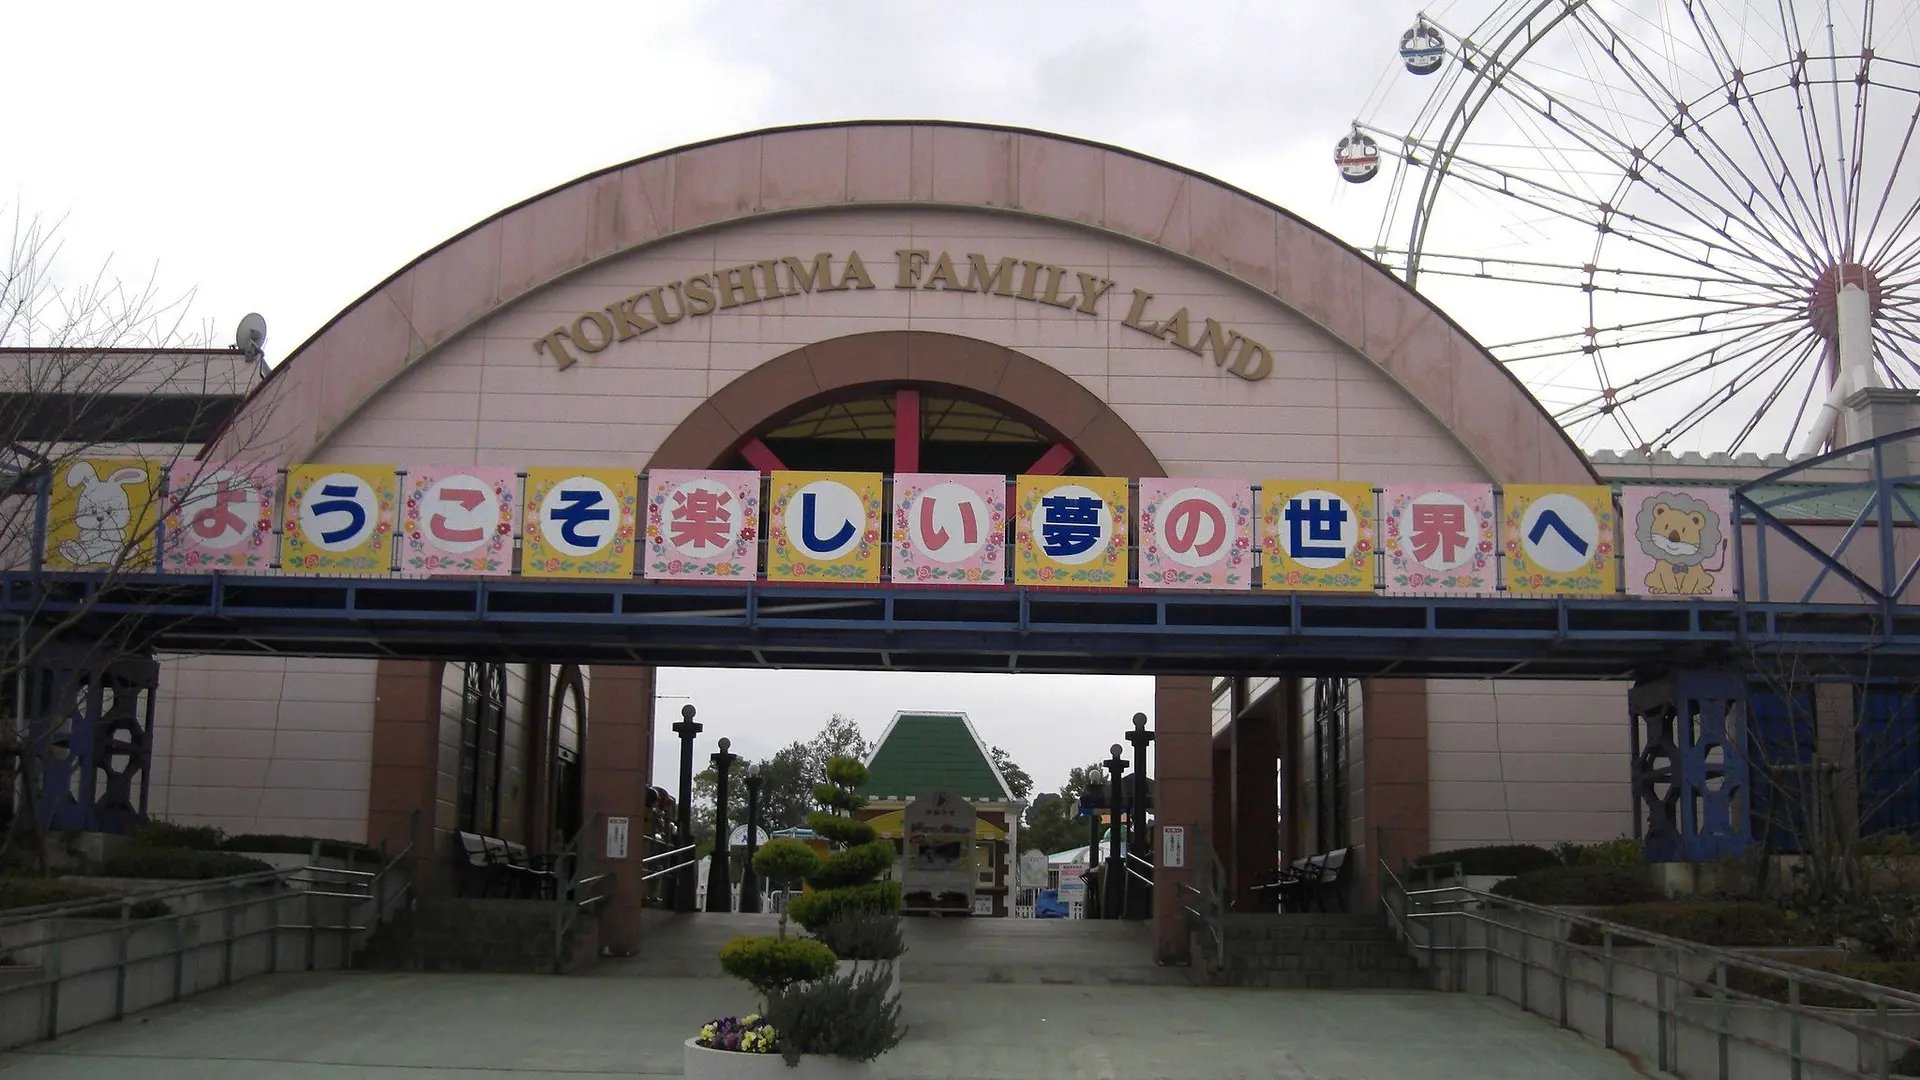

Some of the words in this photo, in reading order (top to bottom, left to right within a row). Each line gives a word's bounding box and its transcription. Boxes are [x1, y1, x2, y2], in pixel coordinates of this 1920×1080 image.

[533, 250, 876, 372] TOKUSHIMA
[895, 249, 1116, 316] FAMILY
[1121, 288, 1273, 382] LAND
